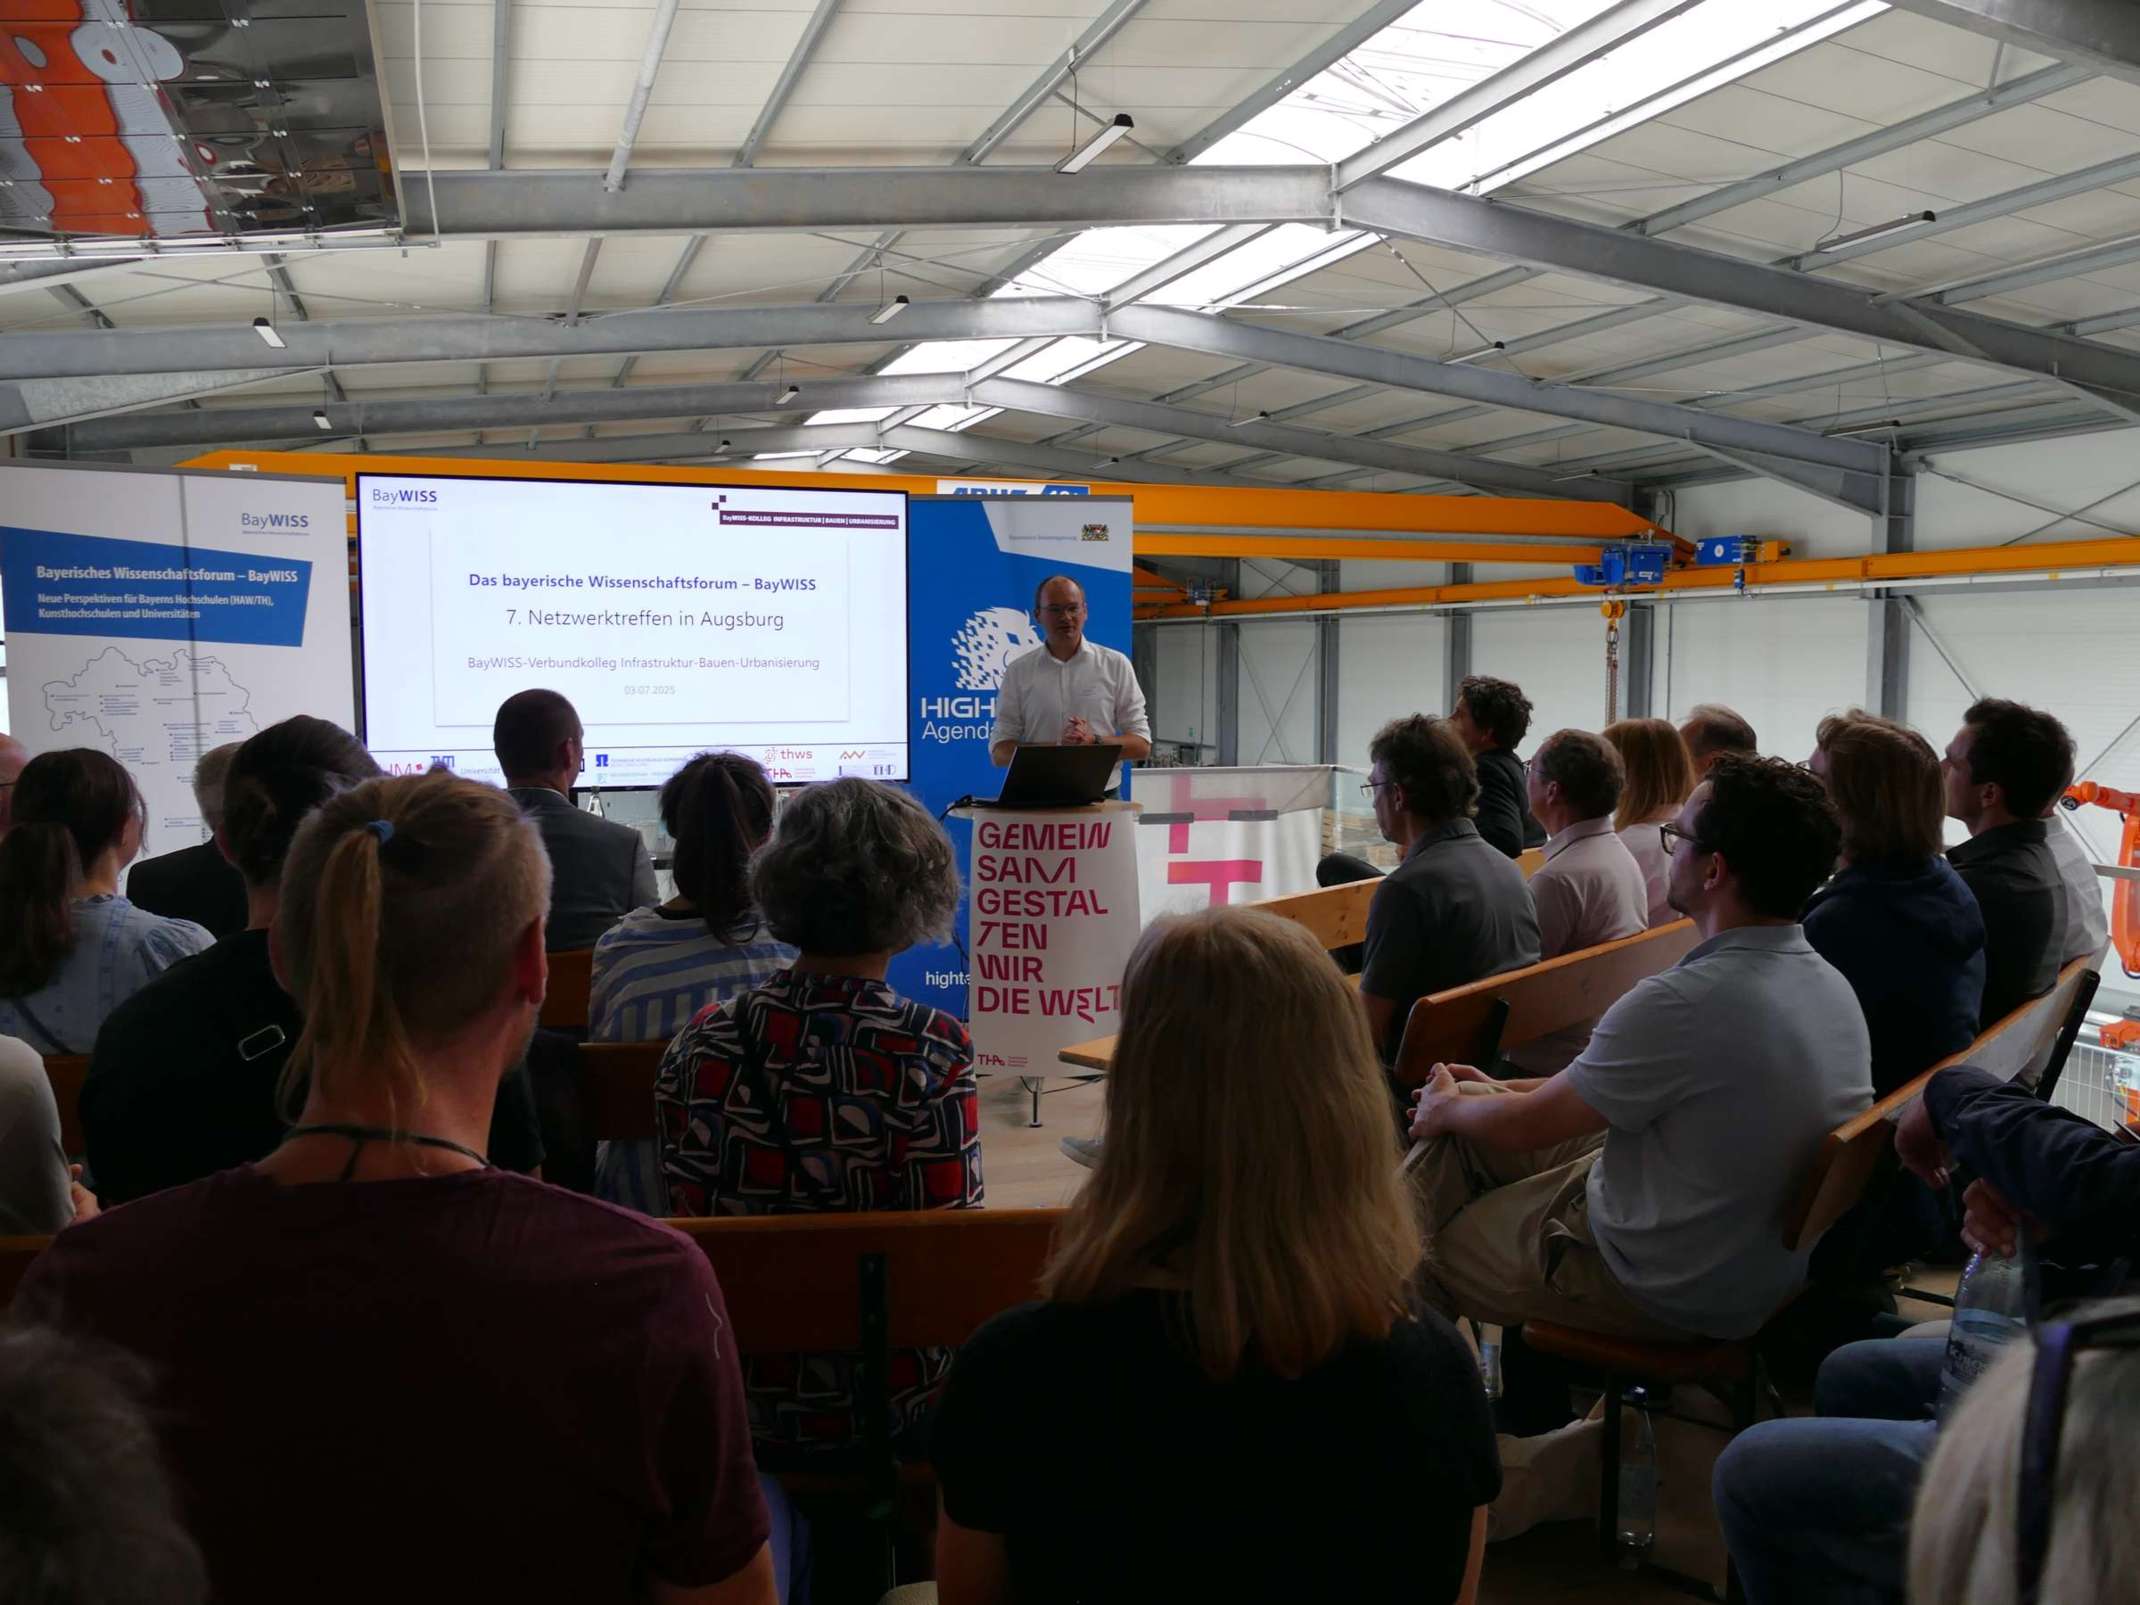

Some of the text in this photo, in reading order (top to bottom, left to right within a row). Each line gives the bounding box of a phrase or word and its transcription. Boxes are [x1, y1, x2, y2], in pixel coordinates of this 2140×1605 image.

[372, 488, 438, 505] BayWISS
[241, 512, 309, 530] BayWISS
[36, 565, 111, 581] Bayerisches
[113, 566, 235, 581] Wissenschaftsforum
[248, 569, 298, 585] BayWISS
[469, 573, 498, 587] Das
[502, 574, 584, 590] bayerische
[588, 575, 738, 590] Wissenschaftsforum
[754, 577, 817, 592] BayWISS
[64, 593, 123, 606] Perspektiven
[175, 594, 229, 606] Hochschulen
[122, 608, 140, 619] und
[506, 609, 784, 631] 7. Netzwerktreffen in Augsburg
[467, 656, 821, 672] BayWISS-Verbundkolleg Infrastruktur-Bauen-Urbanisierung
[623, 685, 676, 696] 03.07.2025
[922, 720, 994, 744] Agend
[780, 748, 814, 760] thws
[978, 822, 1112, 850] GEMEIN
[977, 854, 1076, 884] SAM
[977, 888, 1109, 917] GESTAL
[976, 921, 1048, 950] TEN
[977, 953, 1044, 983] WIR
[977, 984, 1121, 1024] DIE WELT
